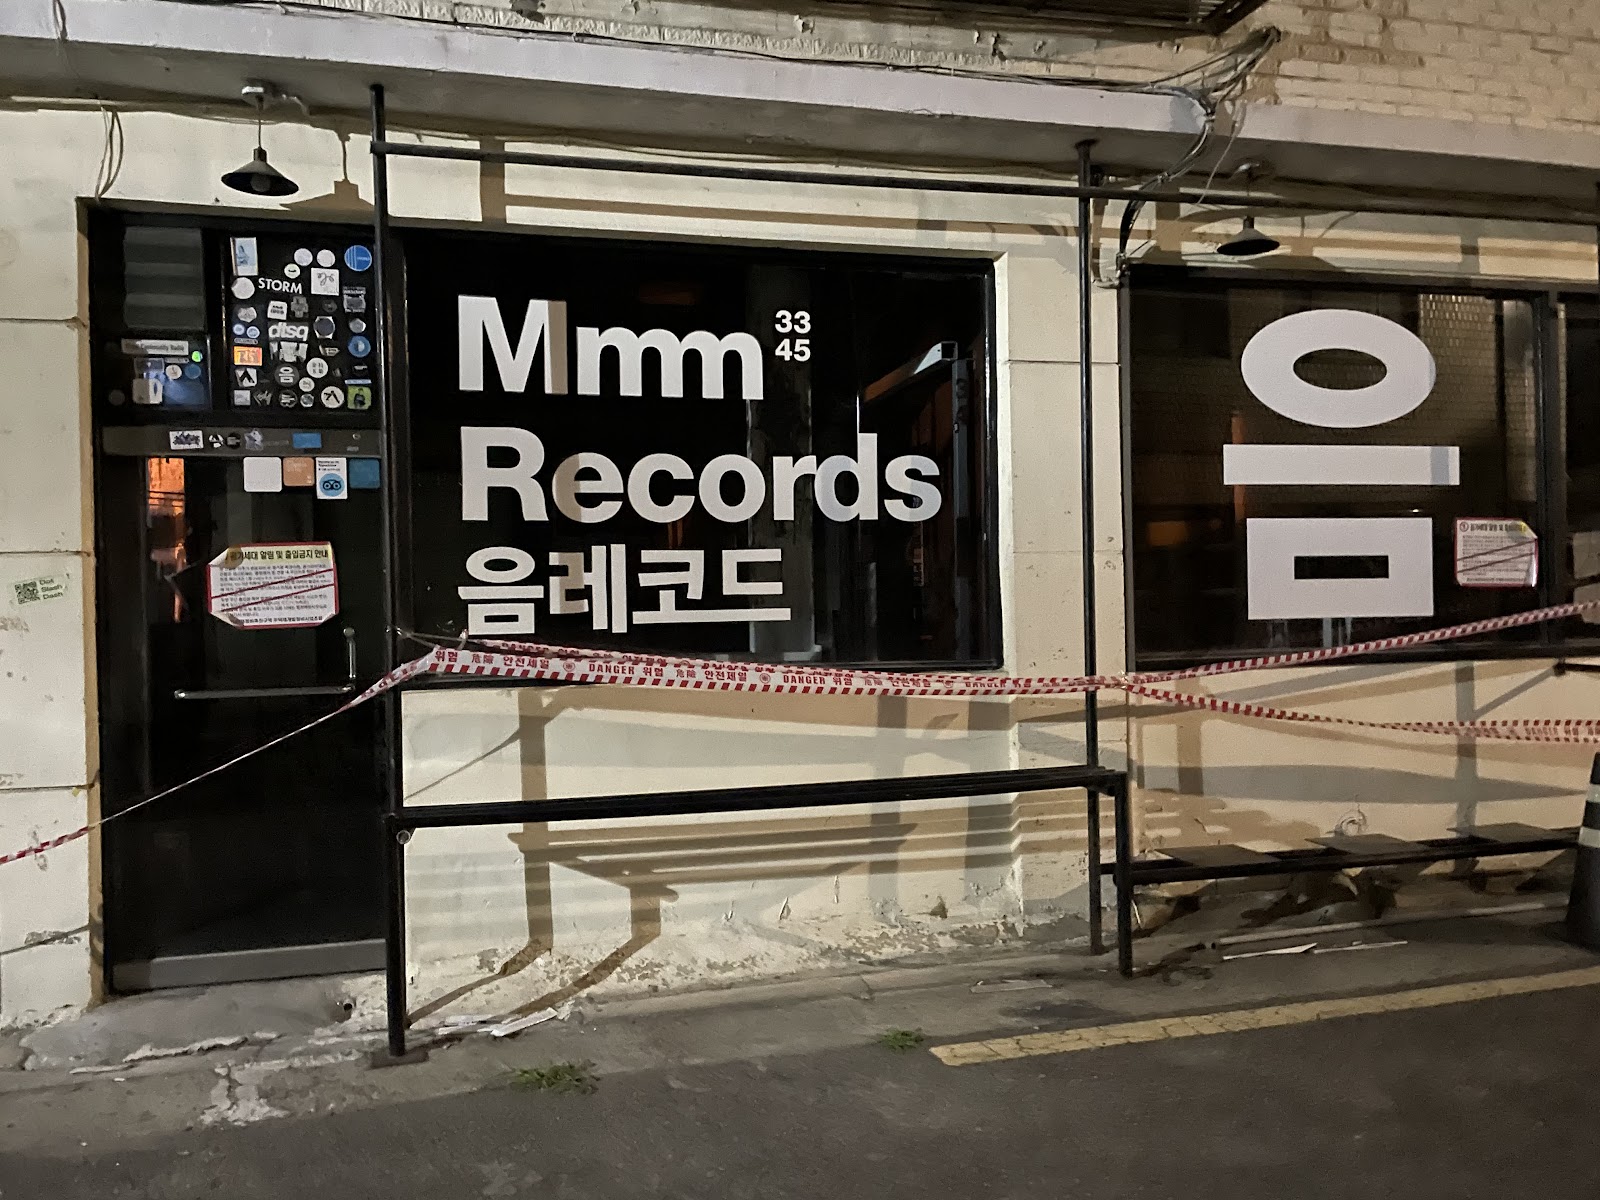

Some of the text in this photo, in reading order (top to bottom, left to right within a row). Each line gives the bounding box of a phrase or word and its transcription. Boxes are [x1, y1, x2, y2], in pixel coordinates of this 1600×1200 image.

[258, 277, 302, 294] STORM
[458, 295, 763, 400] Mmm
[775, 309, 811, 334] 33
[775, 338, 811, 362] 45
[461, 426, 942, 523] Records
[1223, 309, 1460, 620] 음
[458, 544, 791, 636] 음레코드
[435, 650, 458, 662] 위험
[503, 655, 550, 670] 안전제일
[589, 663, 635, 675] DANGER
[643, 667, 664, 678] 위험
[705, 670, 747, 682] 안전제일
[783, 674, 826, 685] DANGER
